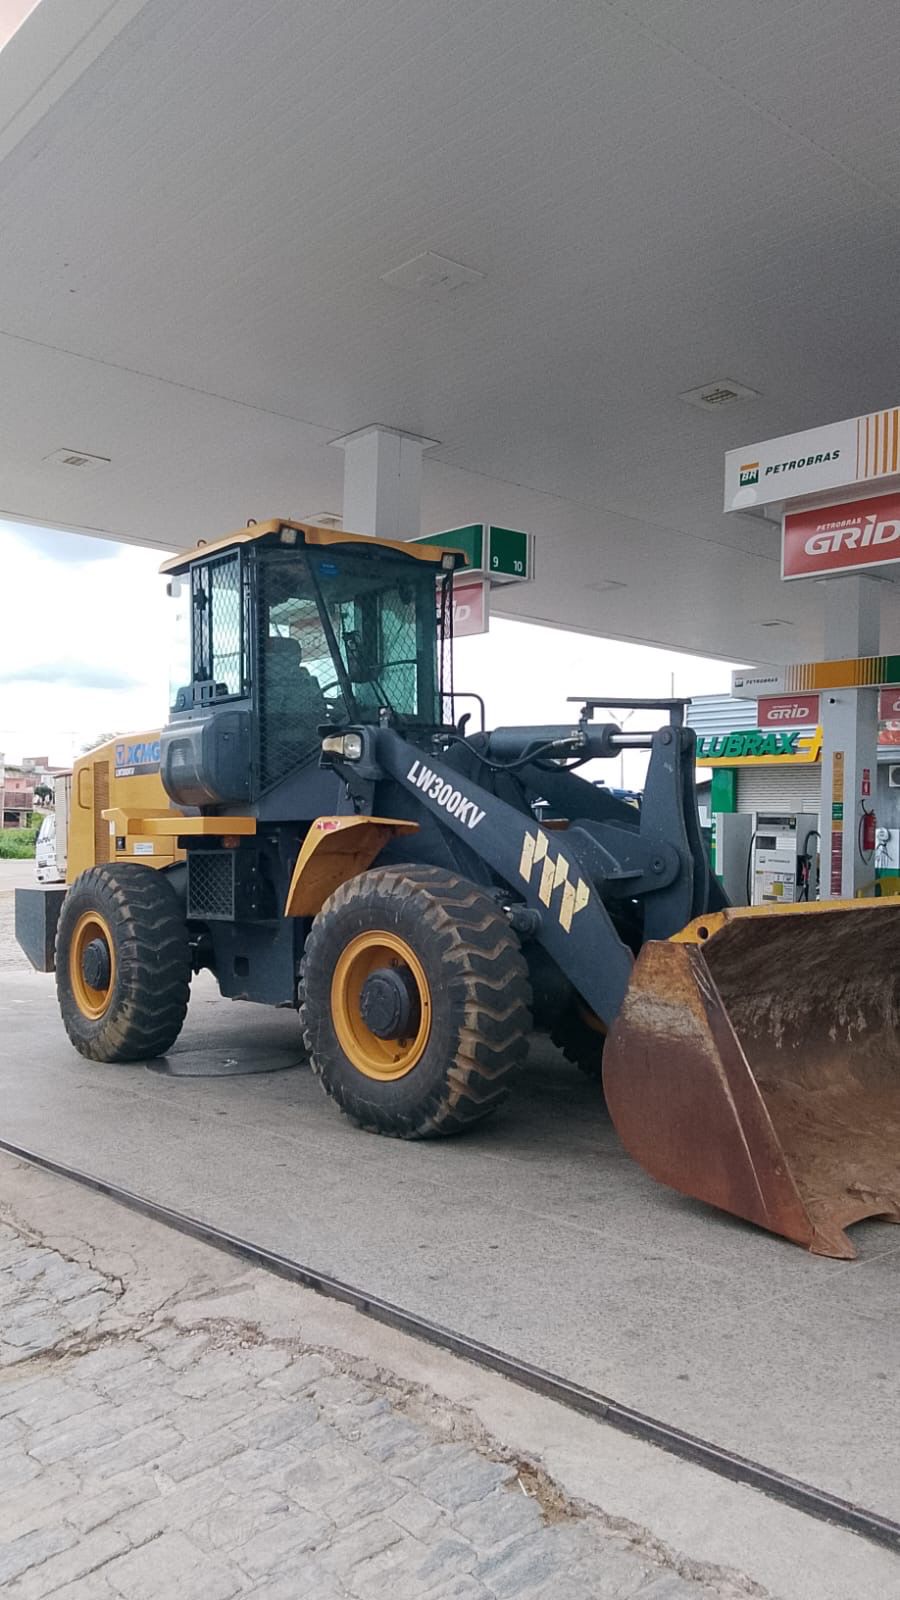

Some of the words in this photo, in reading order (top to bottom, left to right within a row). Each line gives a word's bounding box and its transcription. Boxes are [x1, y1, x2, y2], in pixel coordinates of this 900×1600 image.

[765, 450, 841, 476] PETROBRAS
[816, 517, 862, 531] PETROBRAS
[492, 555, 499, 568] 9
[513, 560, 523, 573] 10
[127, 742, 160, 764] XCMG
[406, 760, 488, 830] LW300KV
